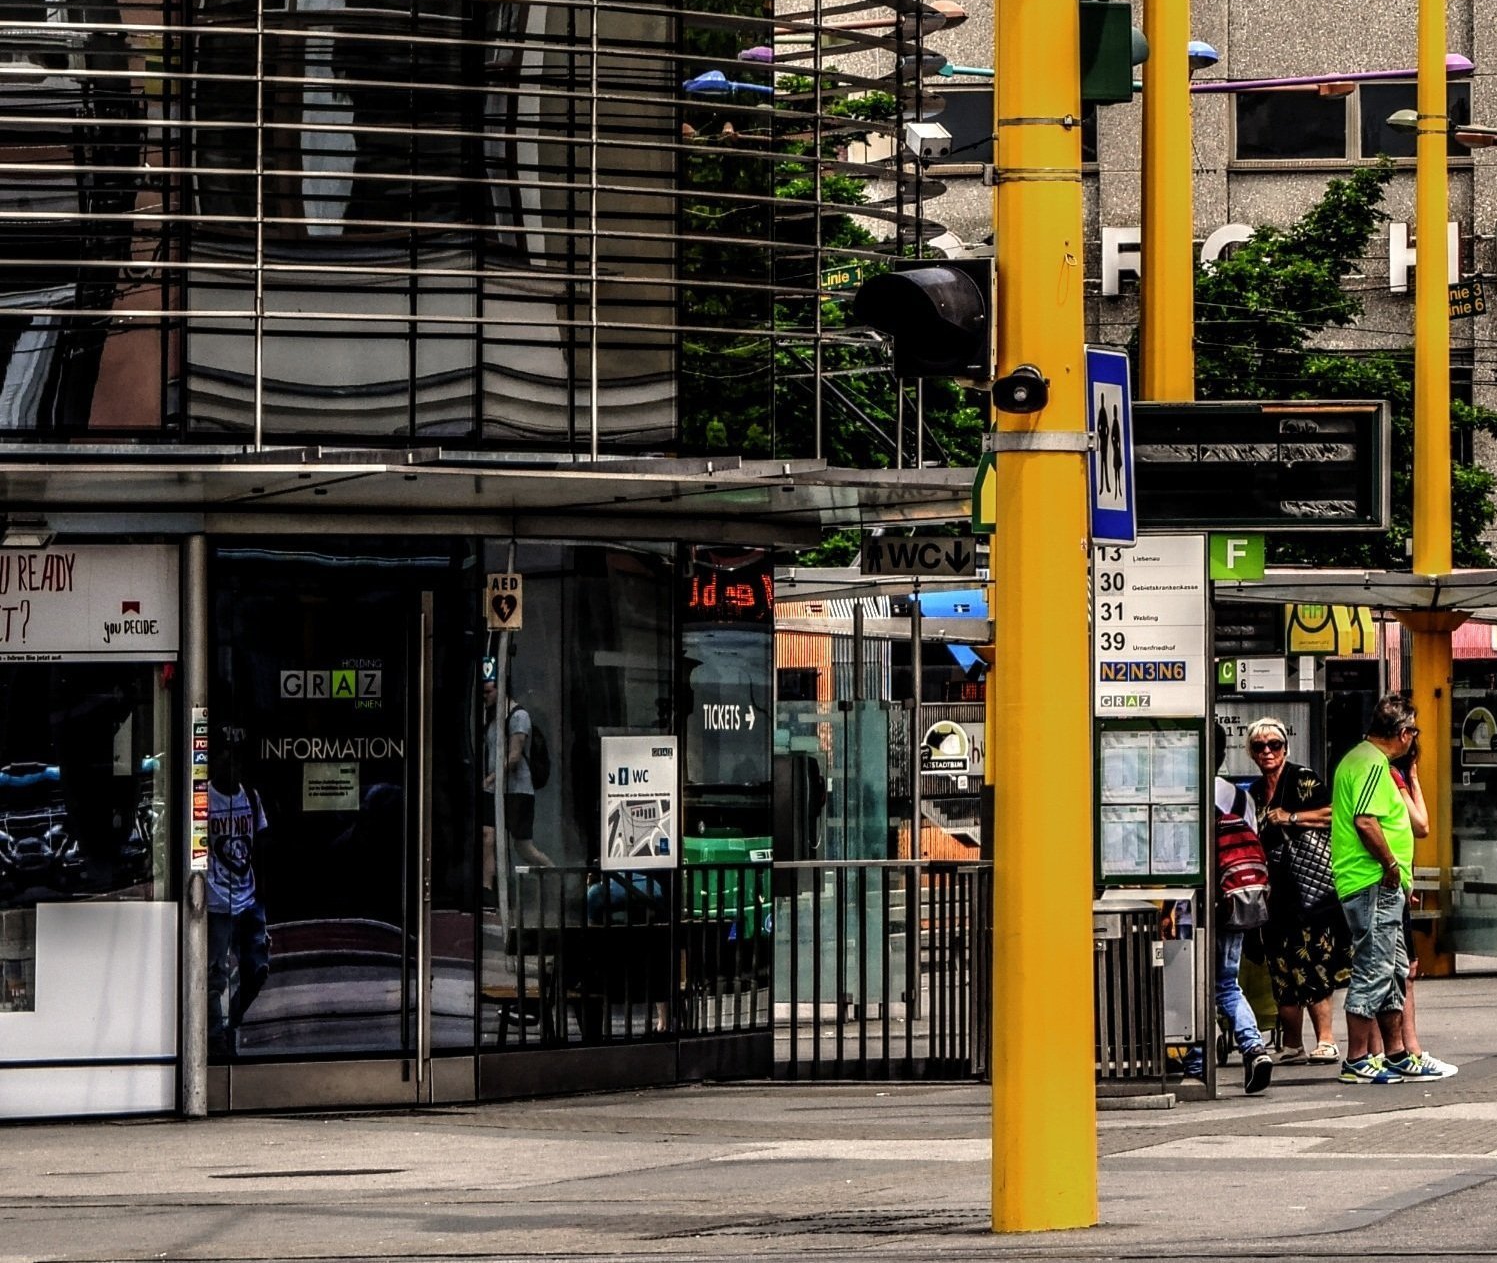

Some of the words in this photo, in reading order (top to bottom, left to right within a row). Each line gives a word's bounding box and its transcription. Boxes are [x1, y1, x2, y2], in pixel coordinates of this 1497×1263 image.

[1473, 283, 1482, 297] 3
[1475, 298, 1484, 312] 6
[887, 542, 942, 571] WC
[1097, 546, 1122, 563] 13
[1226, 539, 1248, 569] F
[17, 553, 76, 592] READY
[491, 576, 519, 591] AED
[1100, 572, 1125, 591] 30
[1100, 602, 1124, 622] 31
[103, 621, 122, 644] you
[1100, 632, 1126, 651] 39
[341, 659, 383, 668] HOLDING
[1101, 663, 1127, 680] N2
[1130, 663, 1156, 680] N3
[1158, 663, 1185, 680] N6
[1222, 662, 1233, 679] C
[1240, 662, 1247, 673] 3
[282, 672, 379, 697] GRAZ
[1240, 678, 1247, 690] 6
[354, 700, 382, 710] LINIEN
[1101, 695, 1151, 707] GRAZ
[702, 703, 741, 731] TICKETS
[261, 737, 405, 760] INFORMATION
[632, 769, 649, 783] WC
